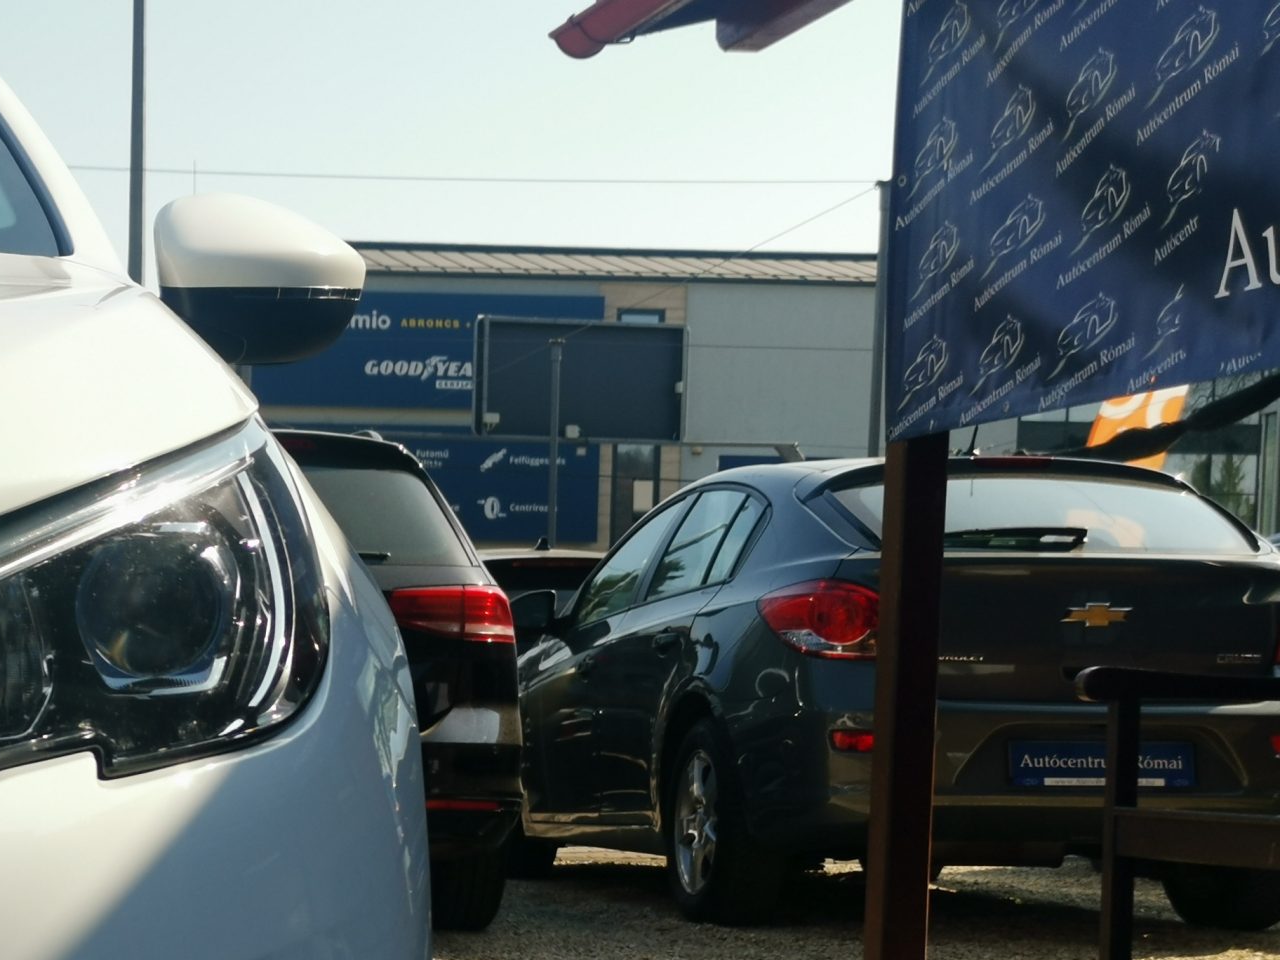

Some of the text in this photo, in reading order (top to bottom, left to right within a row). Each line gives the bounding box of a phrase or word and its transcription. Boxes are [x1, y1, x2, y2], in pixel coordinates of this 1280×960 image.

[1055, 82, 1136, 178] Autócentrum Római
[1136, 41, 1240, 146] Autócentrum Római
[970, 117, 1055, 205] Autócentrum Római
[974, 229, 1063, 312] Autócentrum Római
[1056, 201, 1152, 290] Autócentrum Római
[347, 309, 460, 330] mio ABRONCS
[364, 355, 473, 381] GOODYEA
[1038, 361, 1099, 413] Autócentrum
[1099, 332, 1136, 367] Római
